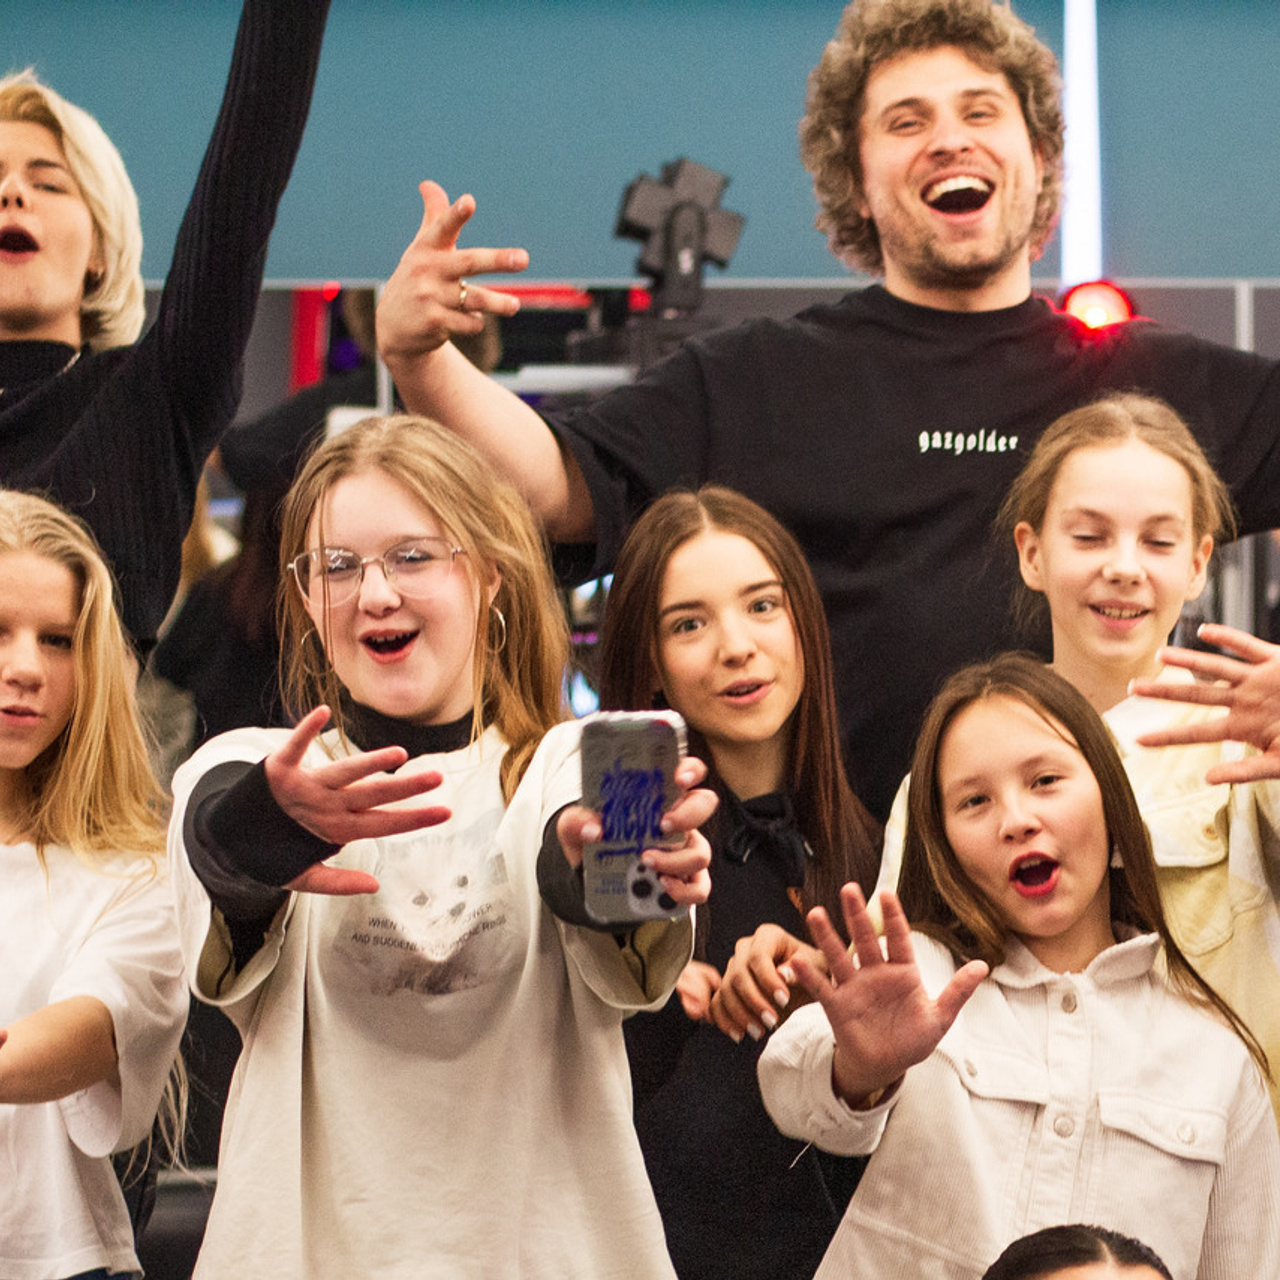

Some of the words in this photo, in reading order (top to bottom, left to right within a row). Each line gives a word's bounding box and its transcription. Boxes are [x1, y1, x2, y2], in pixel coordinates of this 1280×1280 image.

[918, 427, 1018, 456] gazgolder
[368, 917, 397, 931] WHEN
[352, 932, 371, 946] AND
